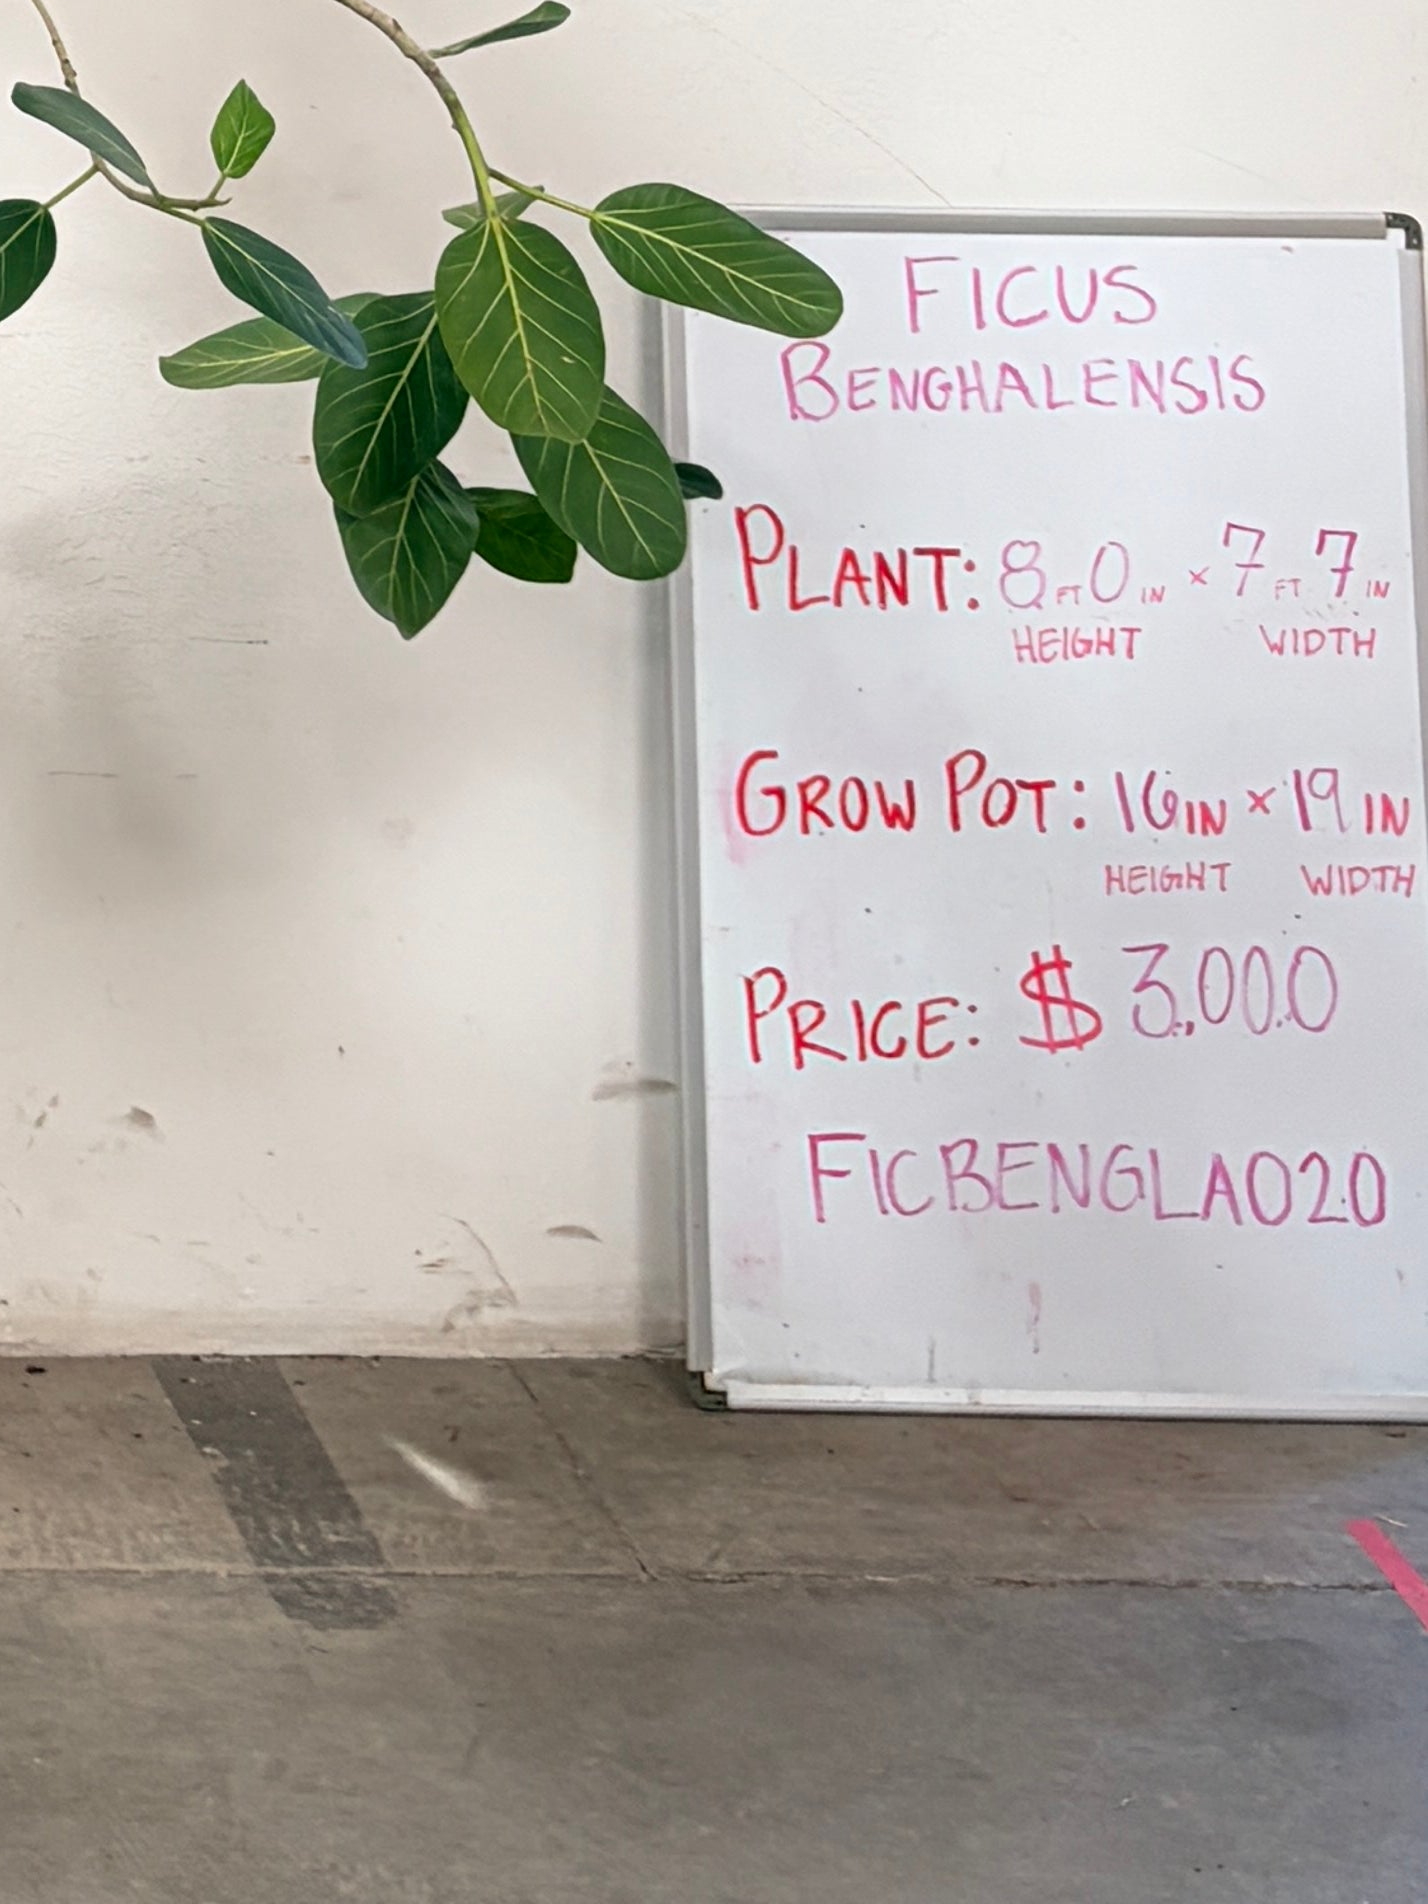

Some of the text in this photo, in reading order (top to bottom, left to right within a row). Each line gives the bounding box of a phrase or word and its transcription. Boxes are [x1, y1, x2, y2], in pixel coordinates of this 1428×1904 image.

[904, 256, 1157, 334] FICUS
[780, 340, 1266, 422] BENGHALENSIS
[734, 503, 980, 612] PLANT:
[1013, 625, 1377, 665] HEIGHT WIDTH
[734, 749, 917, 838] GROW
[944, 749, 1086, 834] POT:
[1104, 862, 1416, 898] HEIGHT WIDTH
[744, 966, 980, 1070] PRICE:
[807, 1132, 1386, 1226] FICBENGLA020
